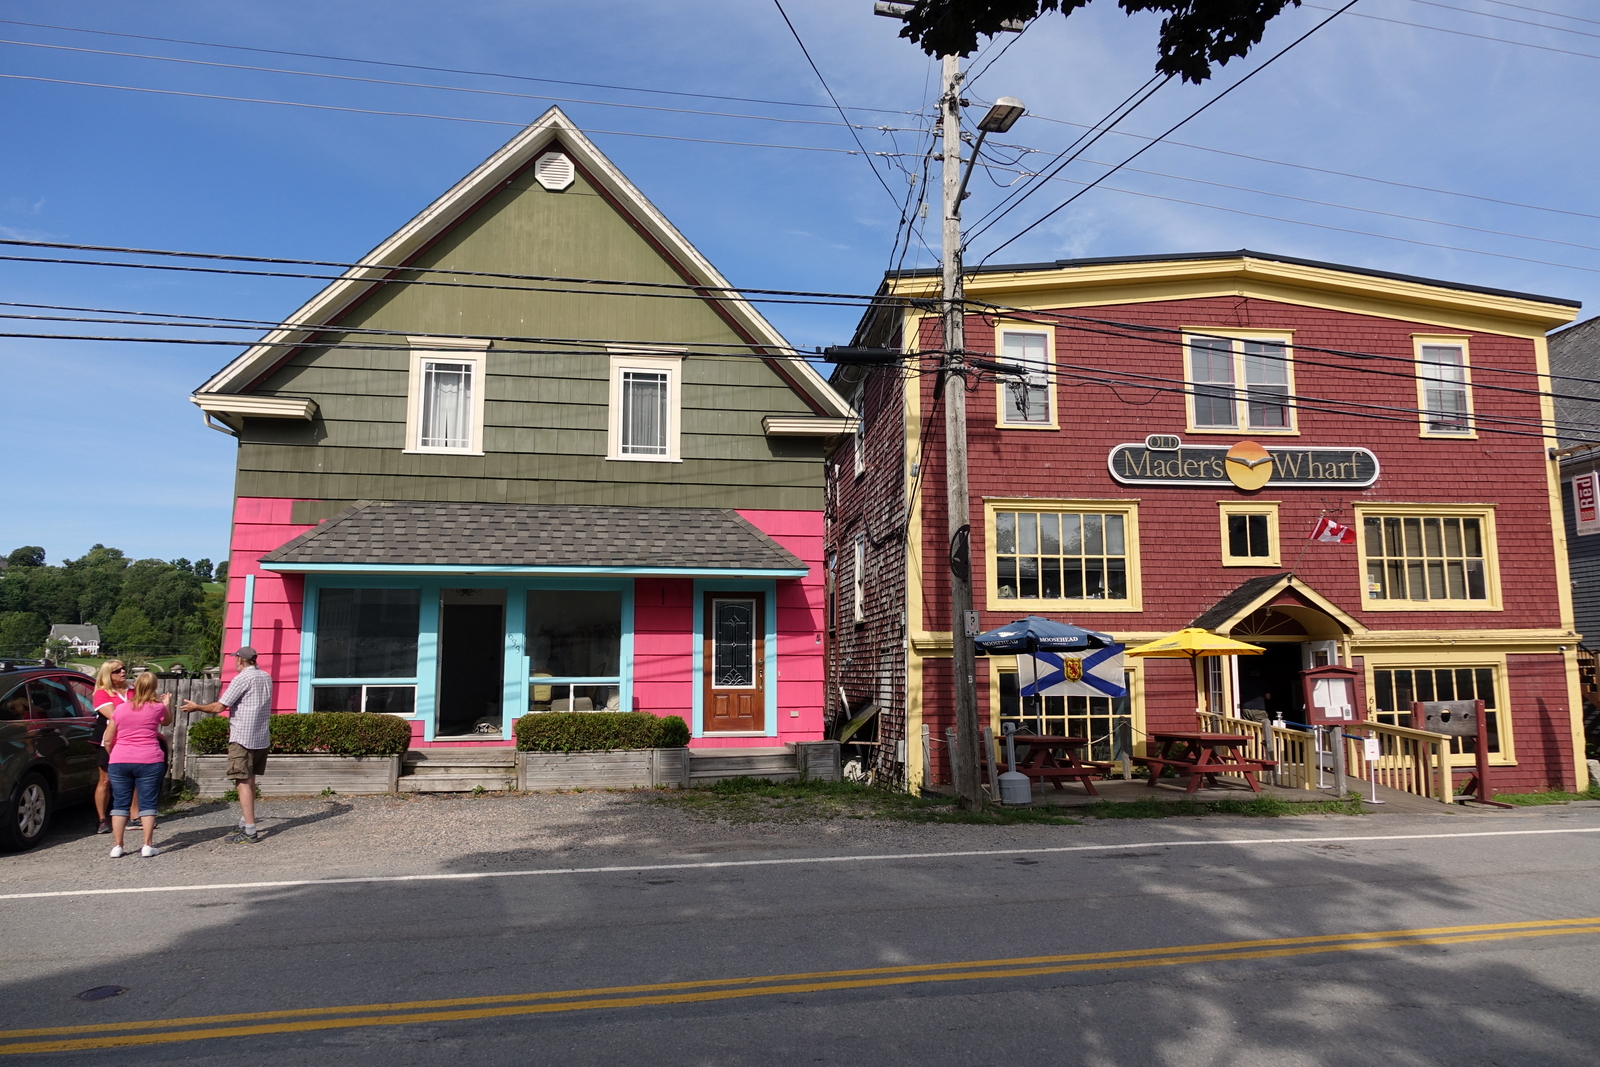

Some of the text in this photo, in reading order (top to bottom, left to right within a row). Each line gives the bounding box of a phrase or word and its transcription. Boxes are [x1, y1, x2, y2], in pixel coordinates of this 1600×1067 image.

[1149, 436, 1178, 448] OLD
[1123, 449, 1363, 479] Mader's Wharf
